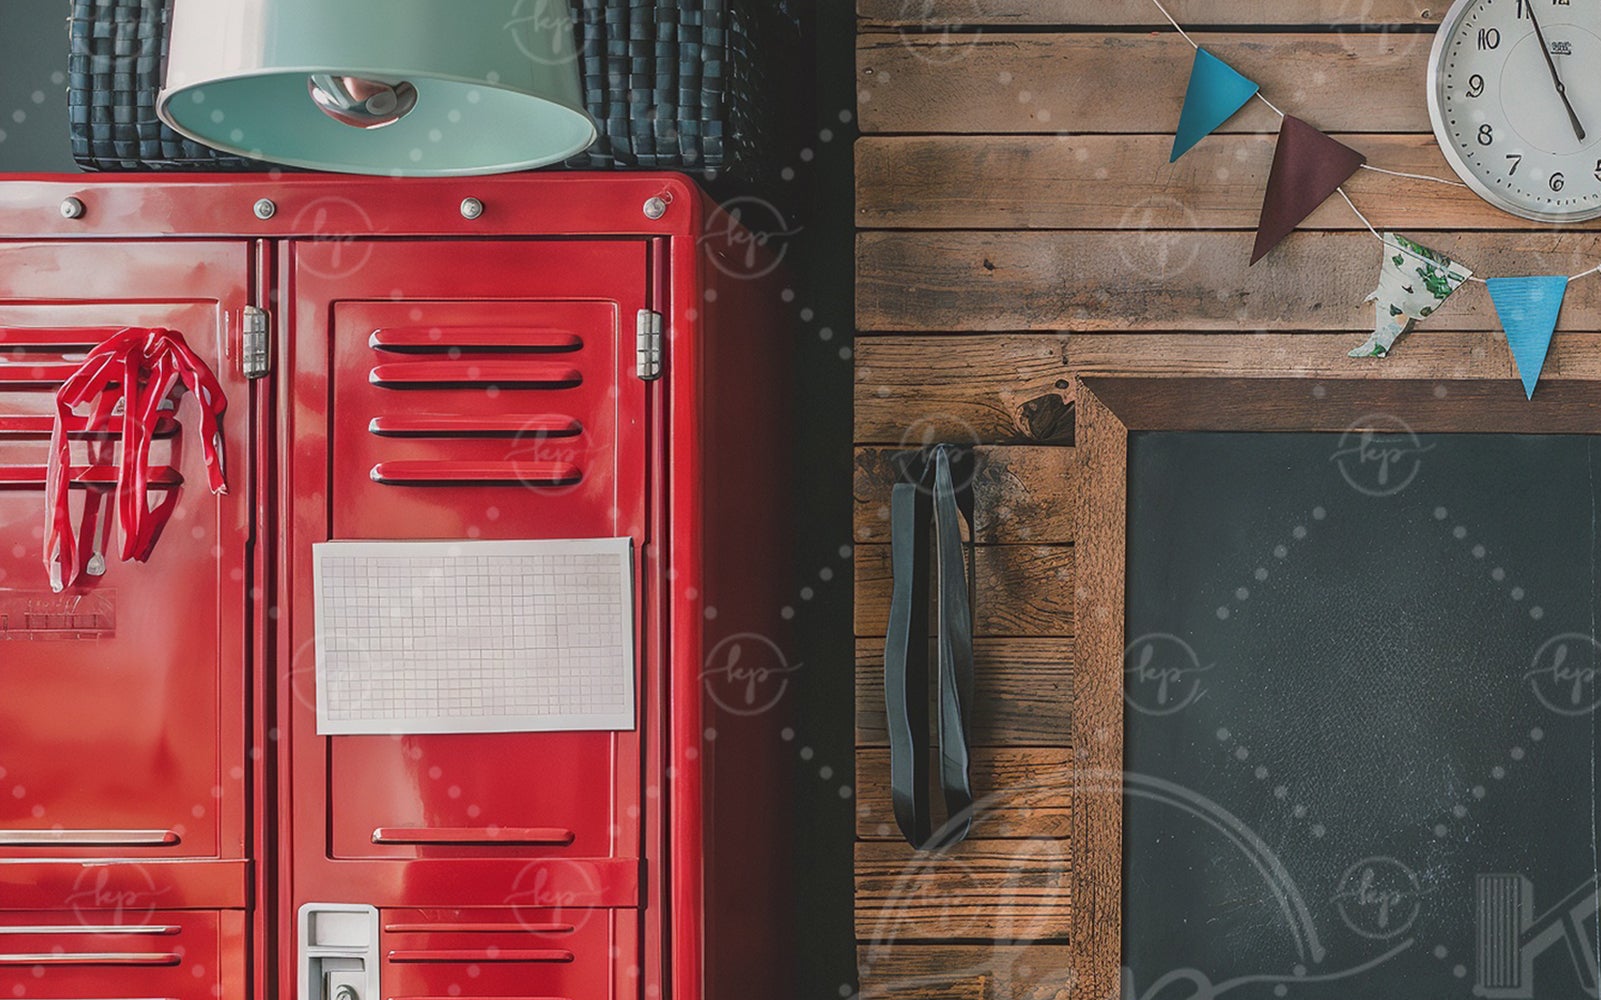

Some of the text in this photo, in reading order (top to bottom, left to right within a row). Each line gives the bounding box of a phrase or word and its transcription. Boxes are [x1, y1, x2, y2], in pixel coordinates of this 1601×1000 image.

[1465, 74, 1485, 99] 9
[1477, 124, 1493, 147] 8
[1505, 154, 1522, 176] 7
[1549, 172, 1565, 192] 6
